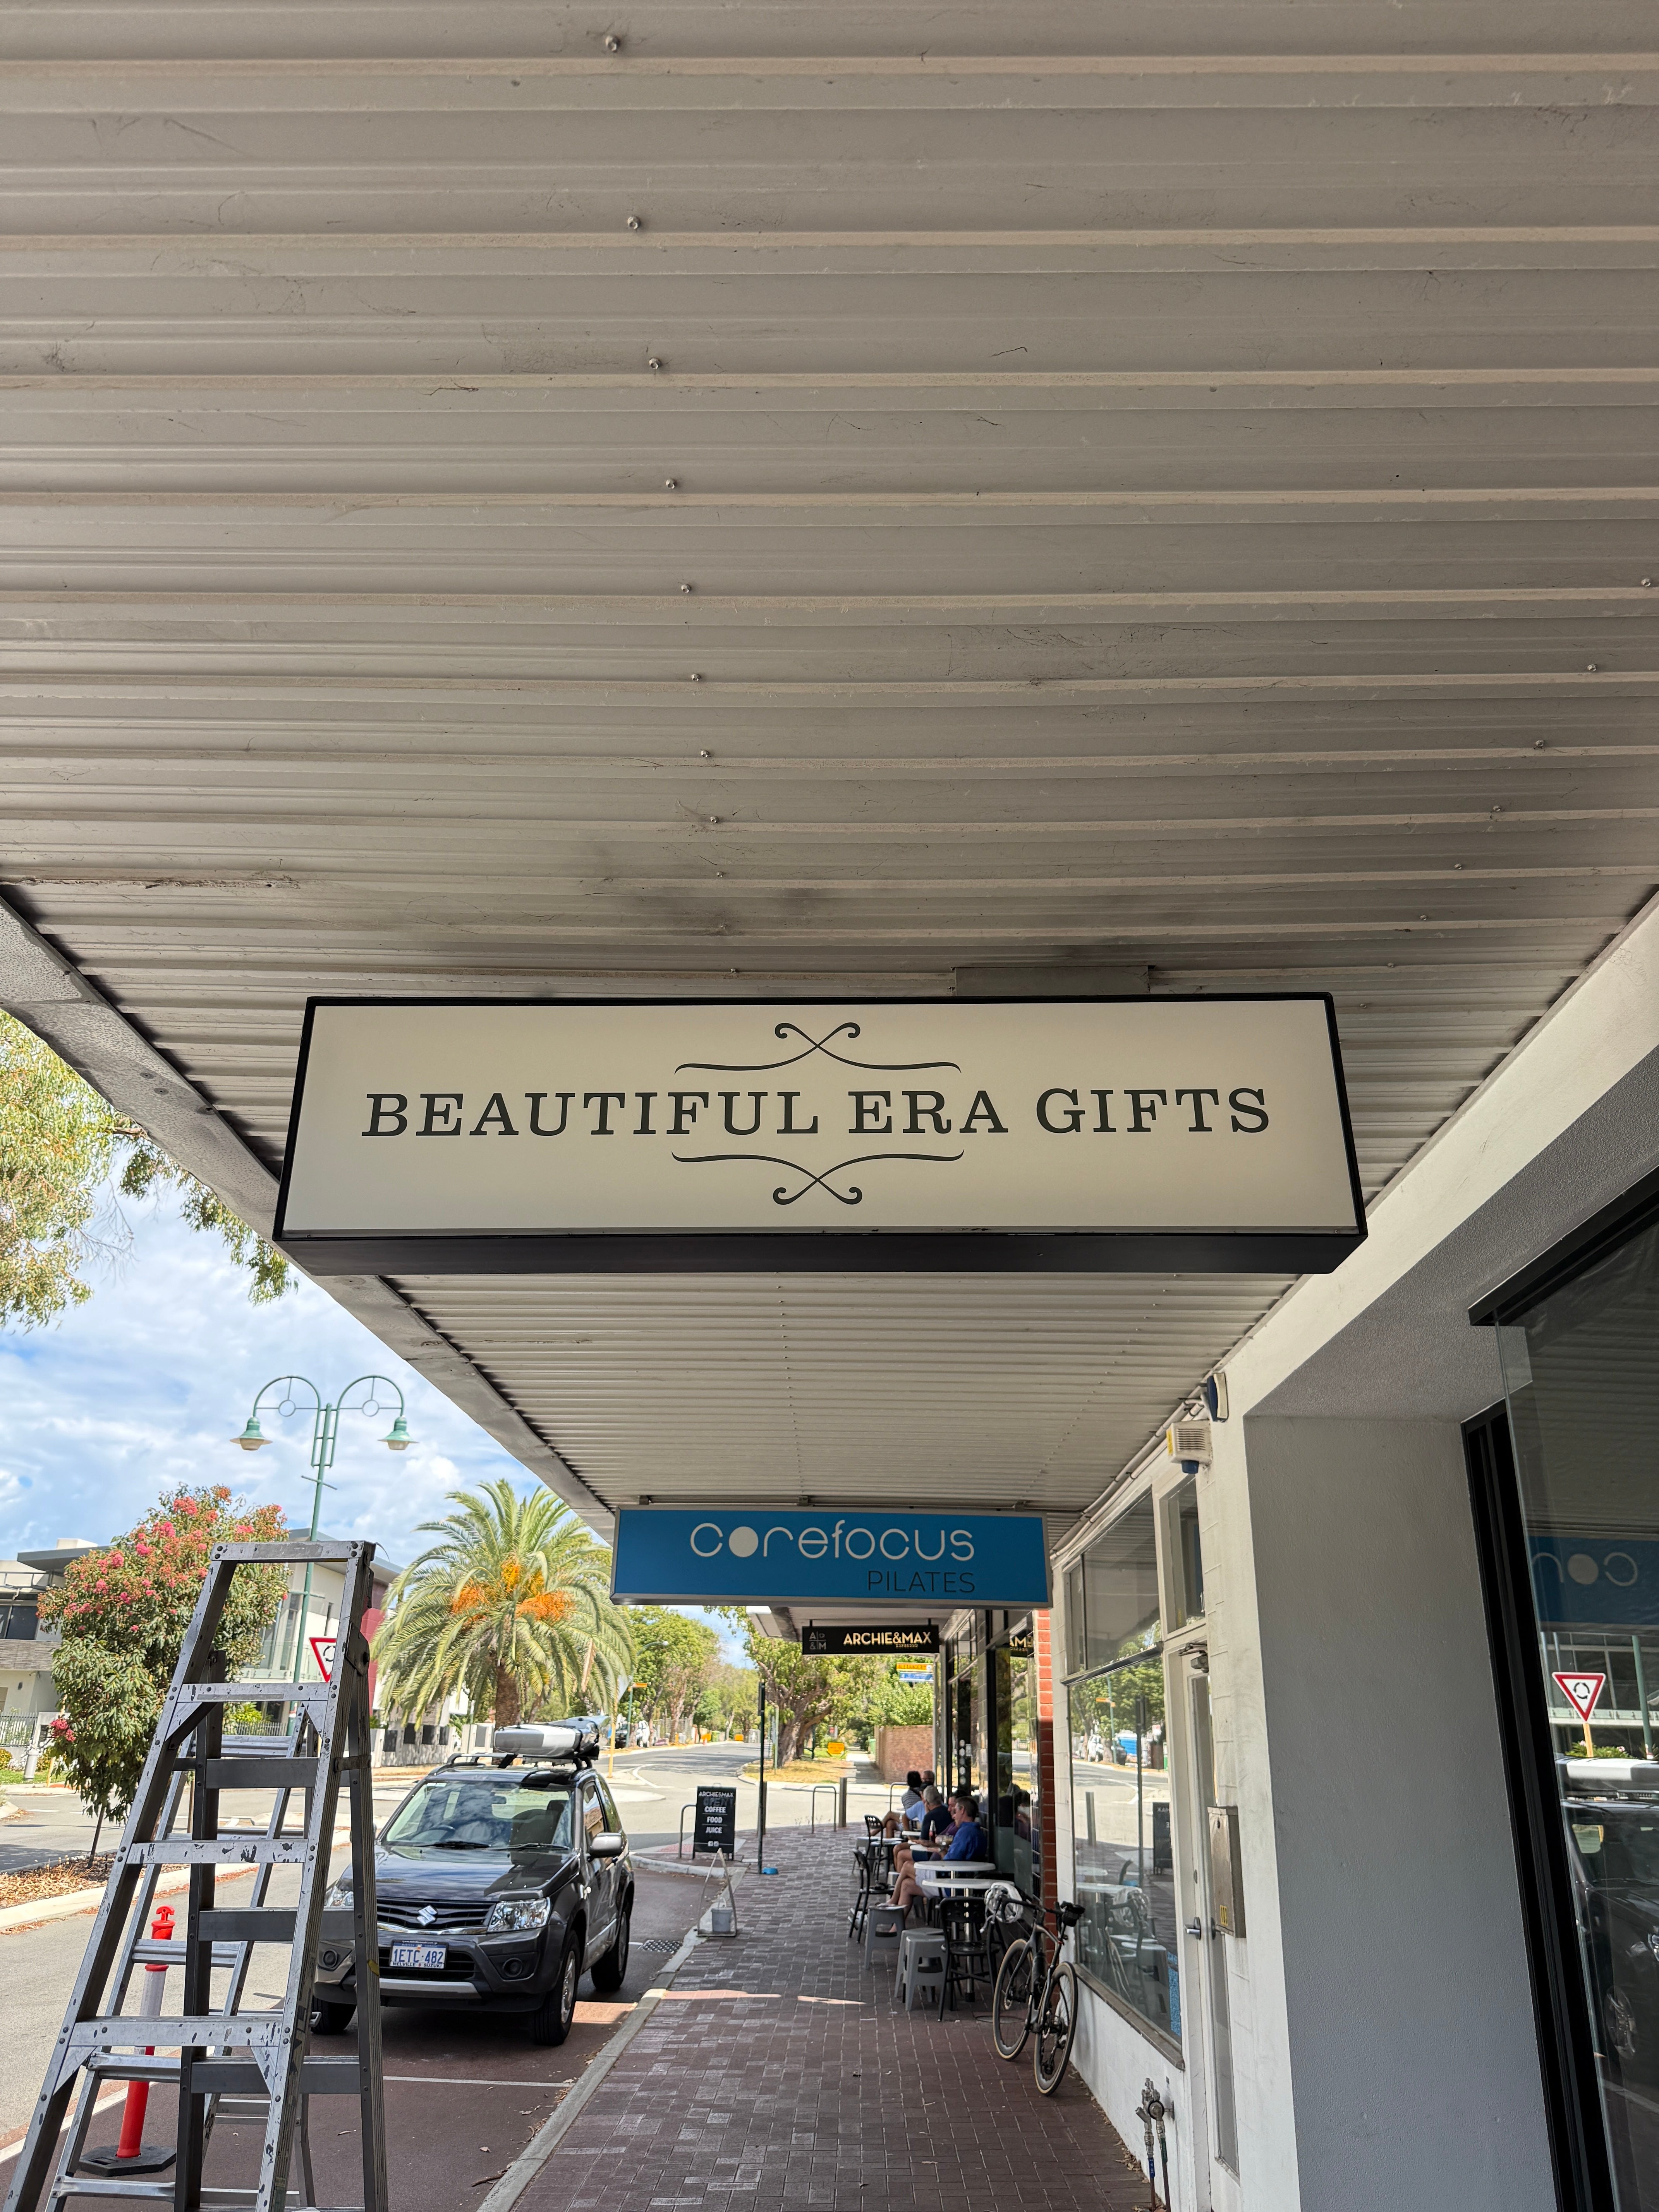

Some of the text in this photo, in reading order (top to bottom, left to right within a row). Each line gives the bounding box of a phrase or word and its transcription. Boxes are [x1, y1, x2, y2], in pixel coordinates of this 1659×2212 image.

[361, 1088, 1270, 1137] BEAUTIFUL ERA GIFTS
[690, 1520, 975, 1561] corefocus
[868, 1570, 975, 1593] PILATES
[843, 1632, 932, 1645] ARCHIE&MAX
